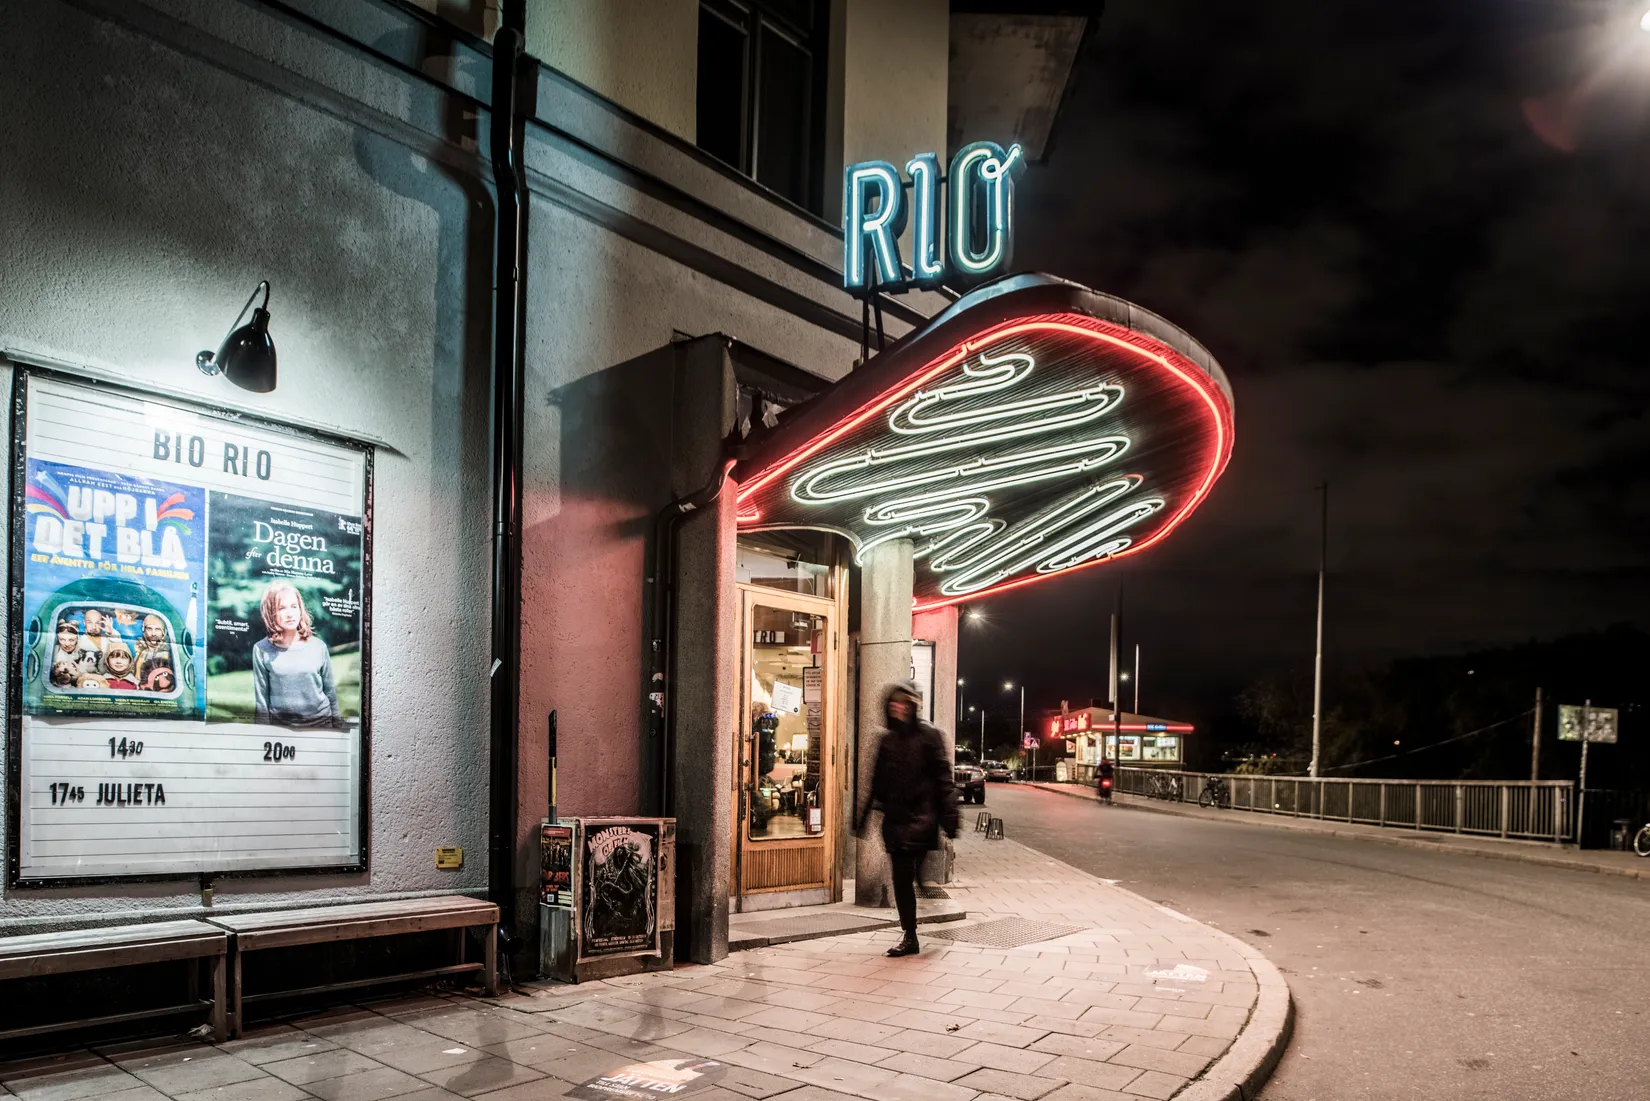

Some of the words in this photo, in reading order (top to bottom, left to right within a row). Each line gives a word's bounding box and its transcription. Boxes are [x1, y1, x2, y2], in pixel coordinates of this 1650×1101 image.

[844, 141, 1022, 288] RIO
[153, 427, 205, 468] BIO
[223, 442, 272, 481] RIO
[68, 485, 138, 528] UPP
[145, 497, 158, 532] I
[253, 520, 328, 554] Dagen
[270, 518, 291, 526] Isabelle
[291, 520, 313, 530] Huppert
[33, 515, 107, 560] DET
[117, 526, 187, 570] BLÅ
[245, 546, 262, 559] efter
[98, 560, 118, 572] FÖR
[121, 565, 144, 576] HELA
[266, 546, 335, 574] denna
[96, 783, 166, 806] JULIETA
[588, 826, 631, 853] MONSTERS
